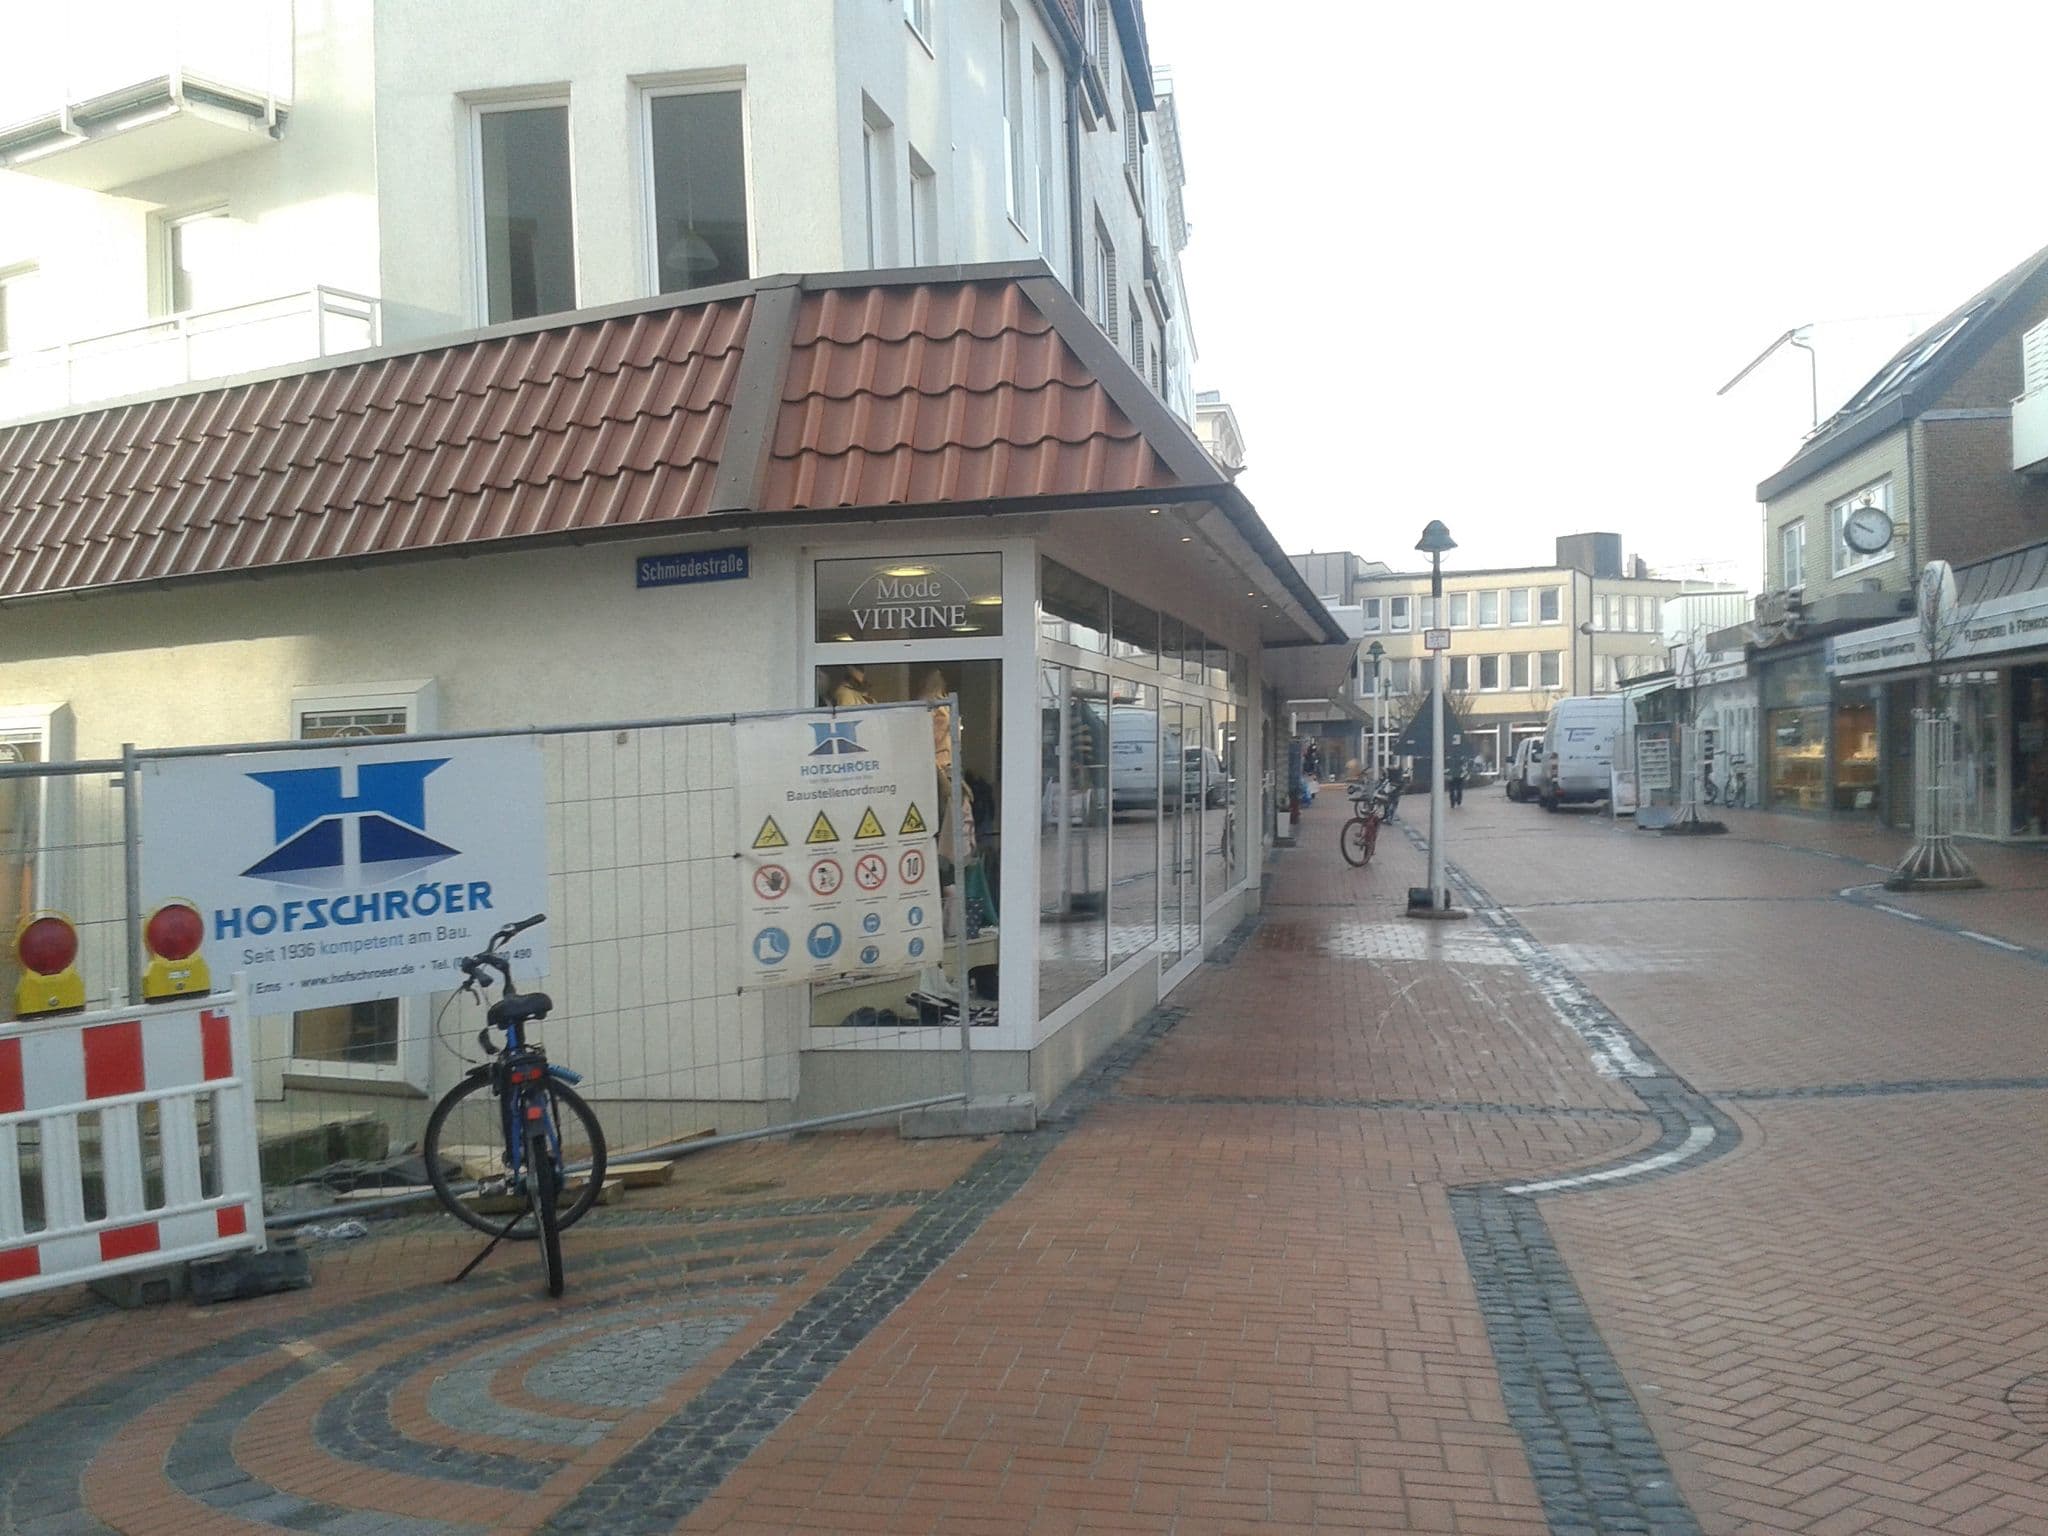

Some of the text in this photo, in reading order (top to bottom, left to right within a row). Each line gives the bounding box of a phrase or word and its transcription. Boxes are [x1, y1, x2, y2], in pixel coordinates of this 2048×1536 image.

[641, 554, 744, 582] Schmiedestraße
[876, 577, 942, 600] Mode
[852, 604, 967, 631] VITRINE
[800, 759, 880, 777] HOFSCHRÖER
[785, 784, 897, 802] Baustellenordnung
[214, 880, 494, 941] HOFSCHRÖER
[243, 926, 472, 966] Seit 1936 kompetent am Bau.
[301, 964, 415, 988] www.hofschroeer.de
